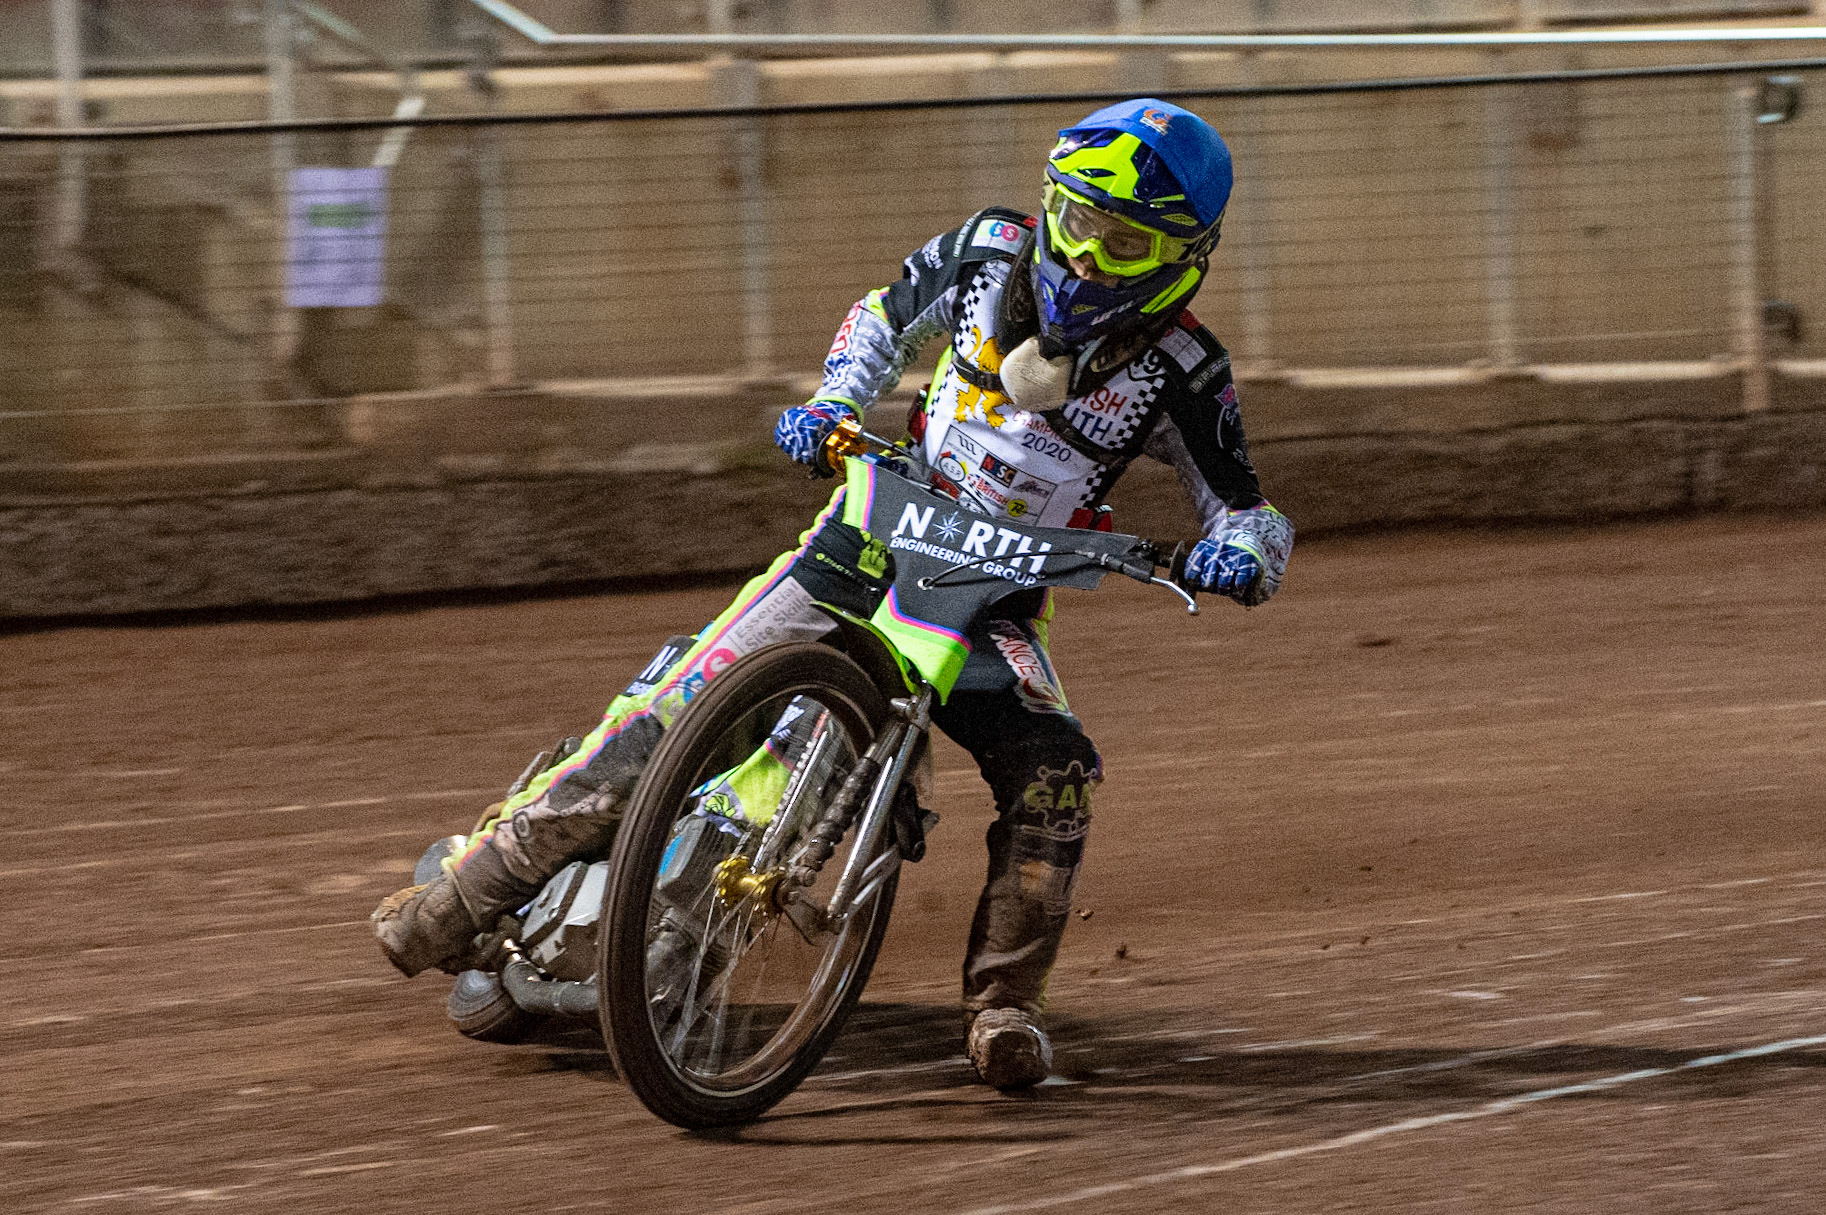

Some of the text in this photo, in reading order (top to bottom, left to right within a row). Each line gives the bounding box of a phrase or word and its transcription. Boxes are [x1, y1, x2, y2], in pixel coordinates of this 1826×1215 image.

[1021, 432, 1071, 462] 2020
[889, 537, 981, 569] ENGINEERING
[982, 560, 1037, 587] GROUP
